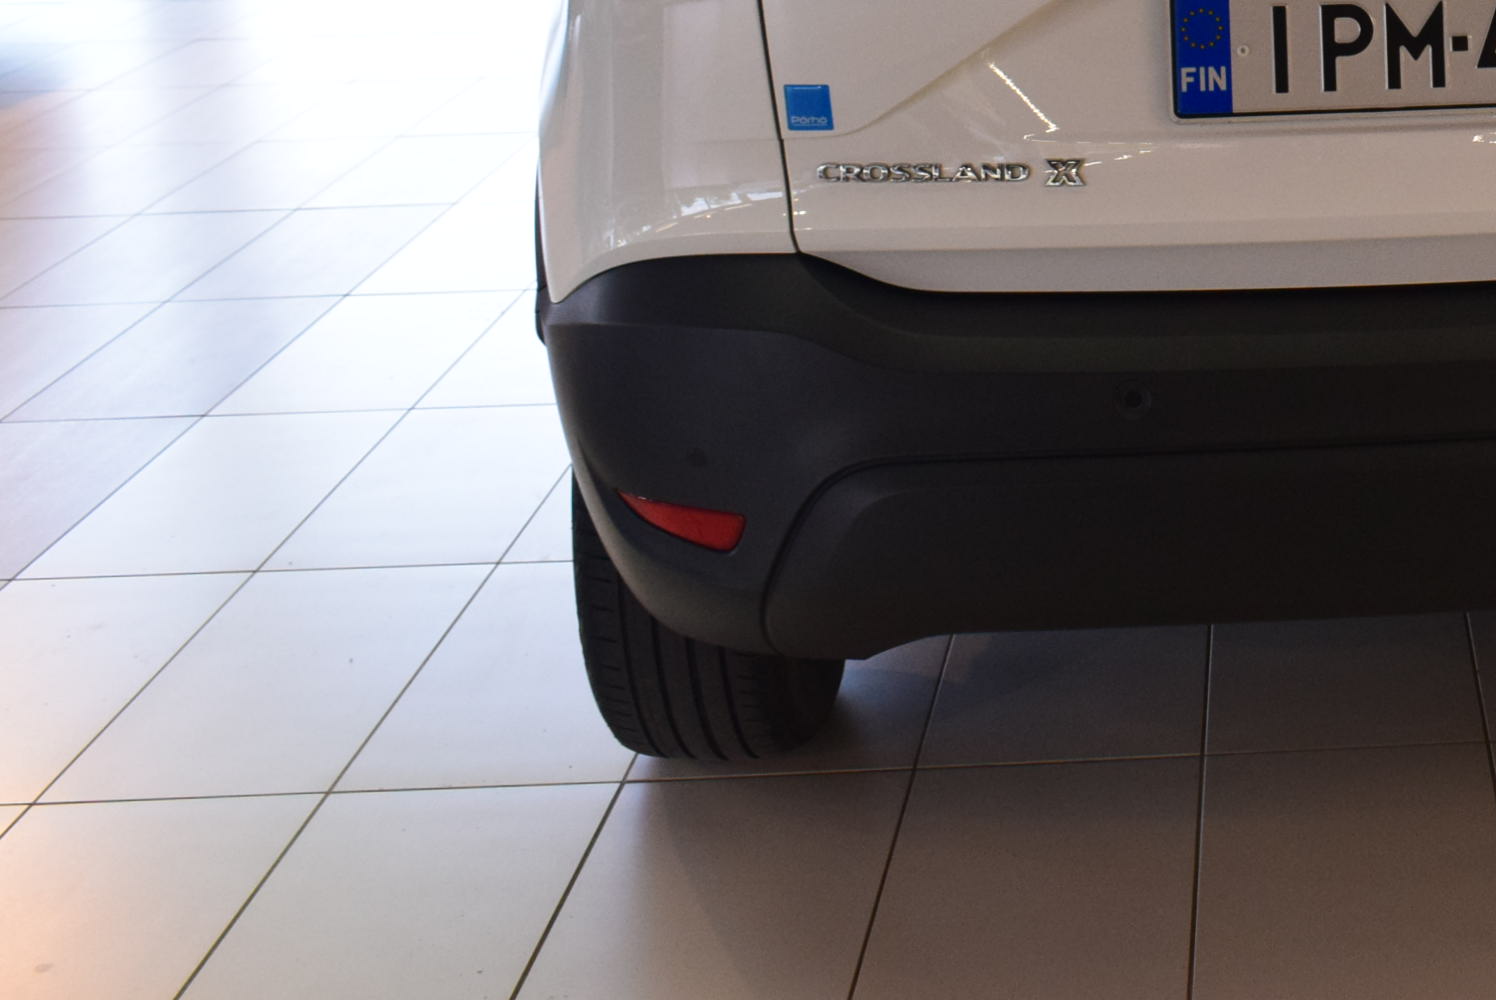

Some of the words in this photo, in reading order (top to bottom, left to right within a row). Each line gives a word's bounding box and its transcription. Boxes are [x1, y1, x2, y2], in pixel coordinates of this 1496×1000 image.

[1181, 65, 1227, 93] FIN
[816, 162, 1031, 183] CROSSLAND
[1044, 158, 1087, 187] X
